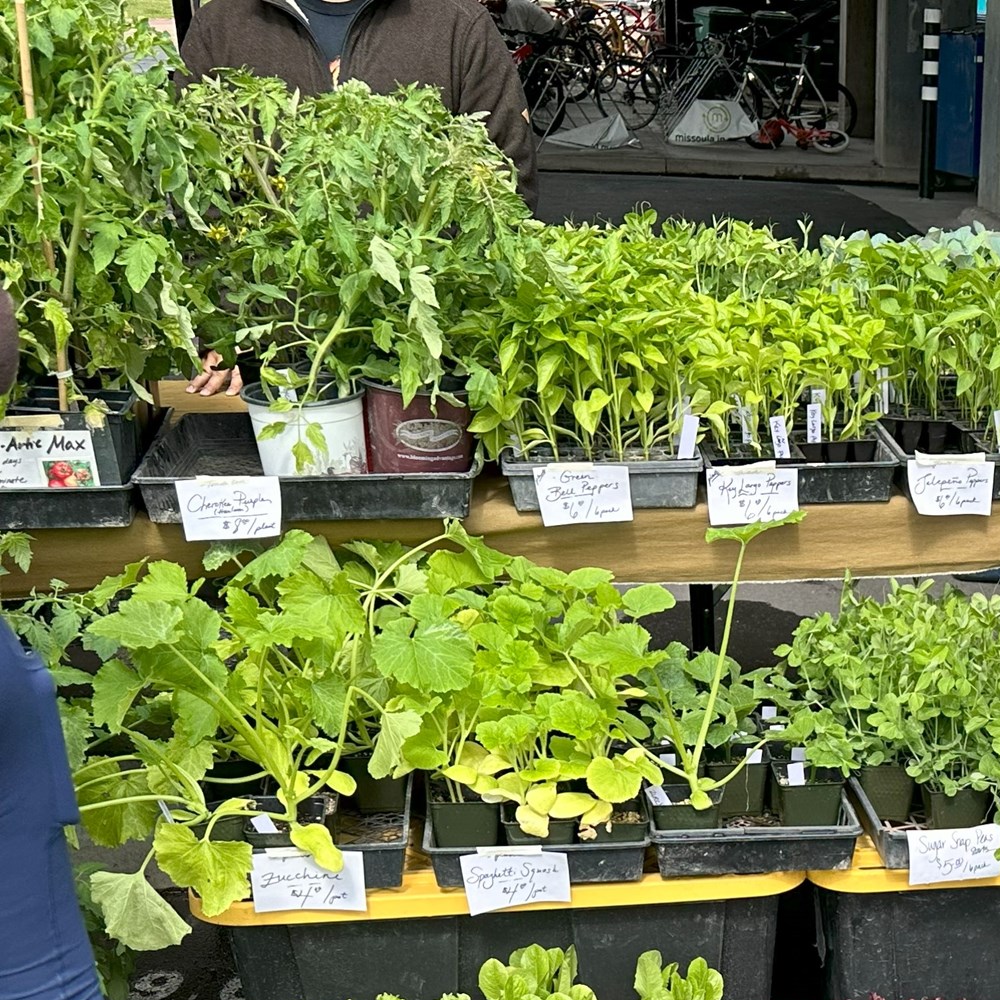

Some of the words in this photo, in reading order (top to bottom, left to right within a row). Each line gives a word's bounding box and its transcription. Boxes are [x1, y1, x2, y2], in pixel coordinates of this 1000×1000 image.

[46, 434, 86, 455] Max
[2, 458, 22, 468] days
[560, 470, 595, 484] Green
[545, 486, 576, 503] Bell
[582, 480, 619, 496] Peppers
[719, 477, 737, 505] Key
[919, 835, 946, 864] Sugar
[950, 830, 971, 852] Snap
[975, 828, 994, 845] Peas
[466, 866, 516, 890] Spaghetti
[520, 862, 559, 884] Squash
